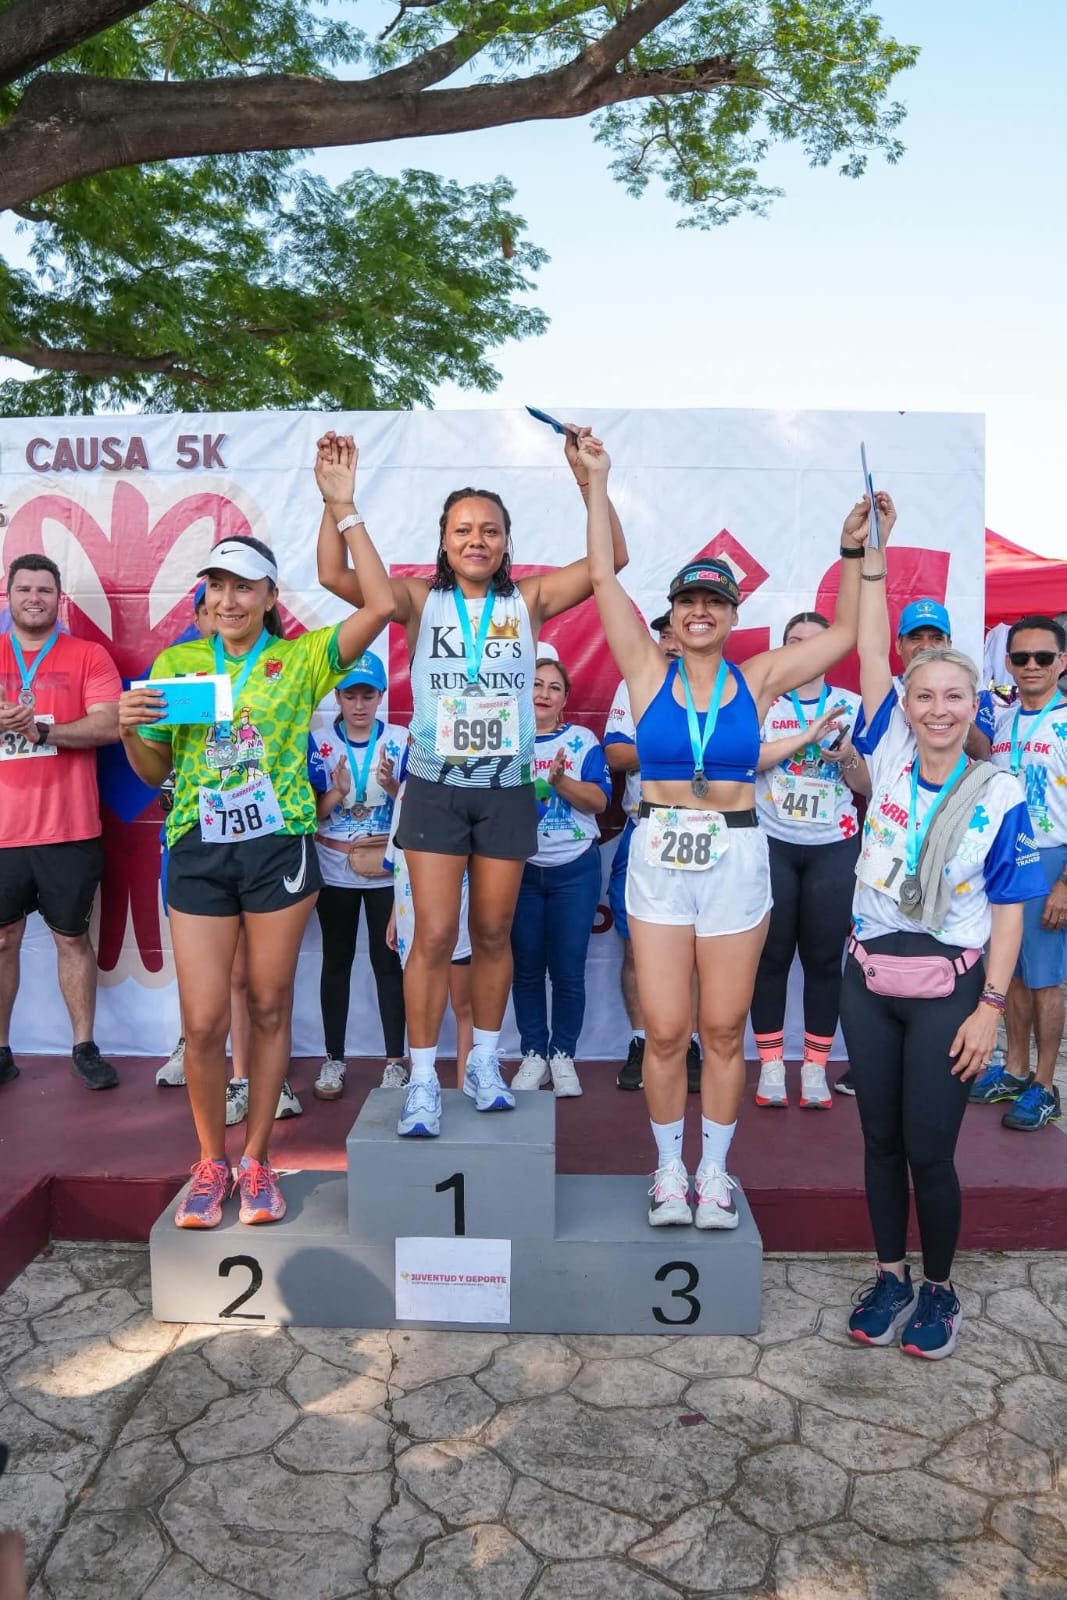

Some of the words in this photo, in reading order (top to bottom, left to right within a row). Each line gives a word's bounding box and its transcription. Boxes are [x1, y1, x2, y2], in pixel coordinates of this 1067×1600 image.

[25, 436, 149, 472] CAUSA
[175, 433, 228, 470] 5K
[453, 719, 502, 751] 699
[1033, 742, 1051, 755] 5K
[215, 803, 263, 836] 738
[782, 792, 820, 818] 441
[661, 830, 712, 865] 288
[435, 1172, 465, 1236] 1
[218, 1254, 266, 1320] 2
[411, 1273, 457, 1282] JUVENTUD
[466, 1275, 507, 1284] DEPORTE
[651, 1260, 701, 1325] 3
